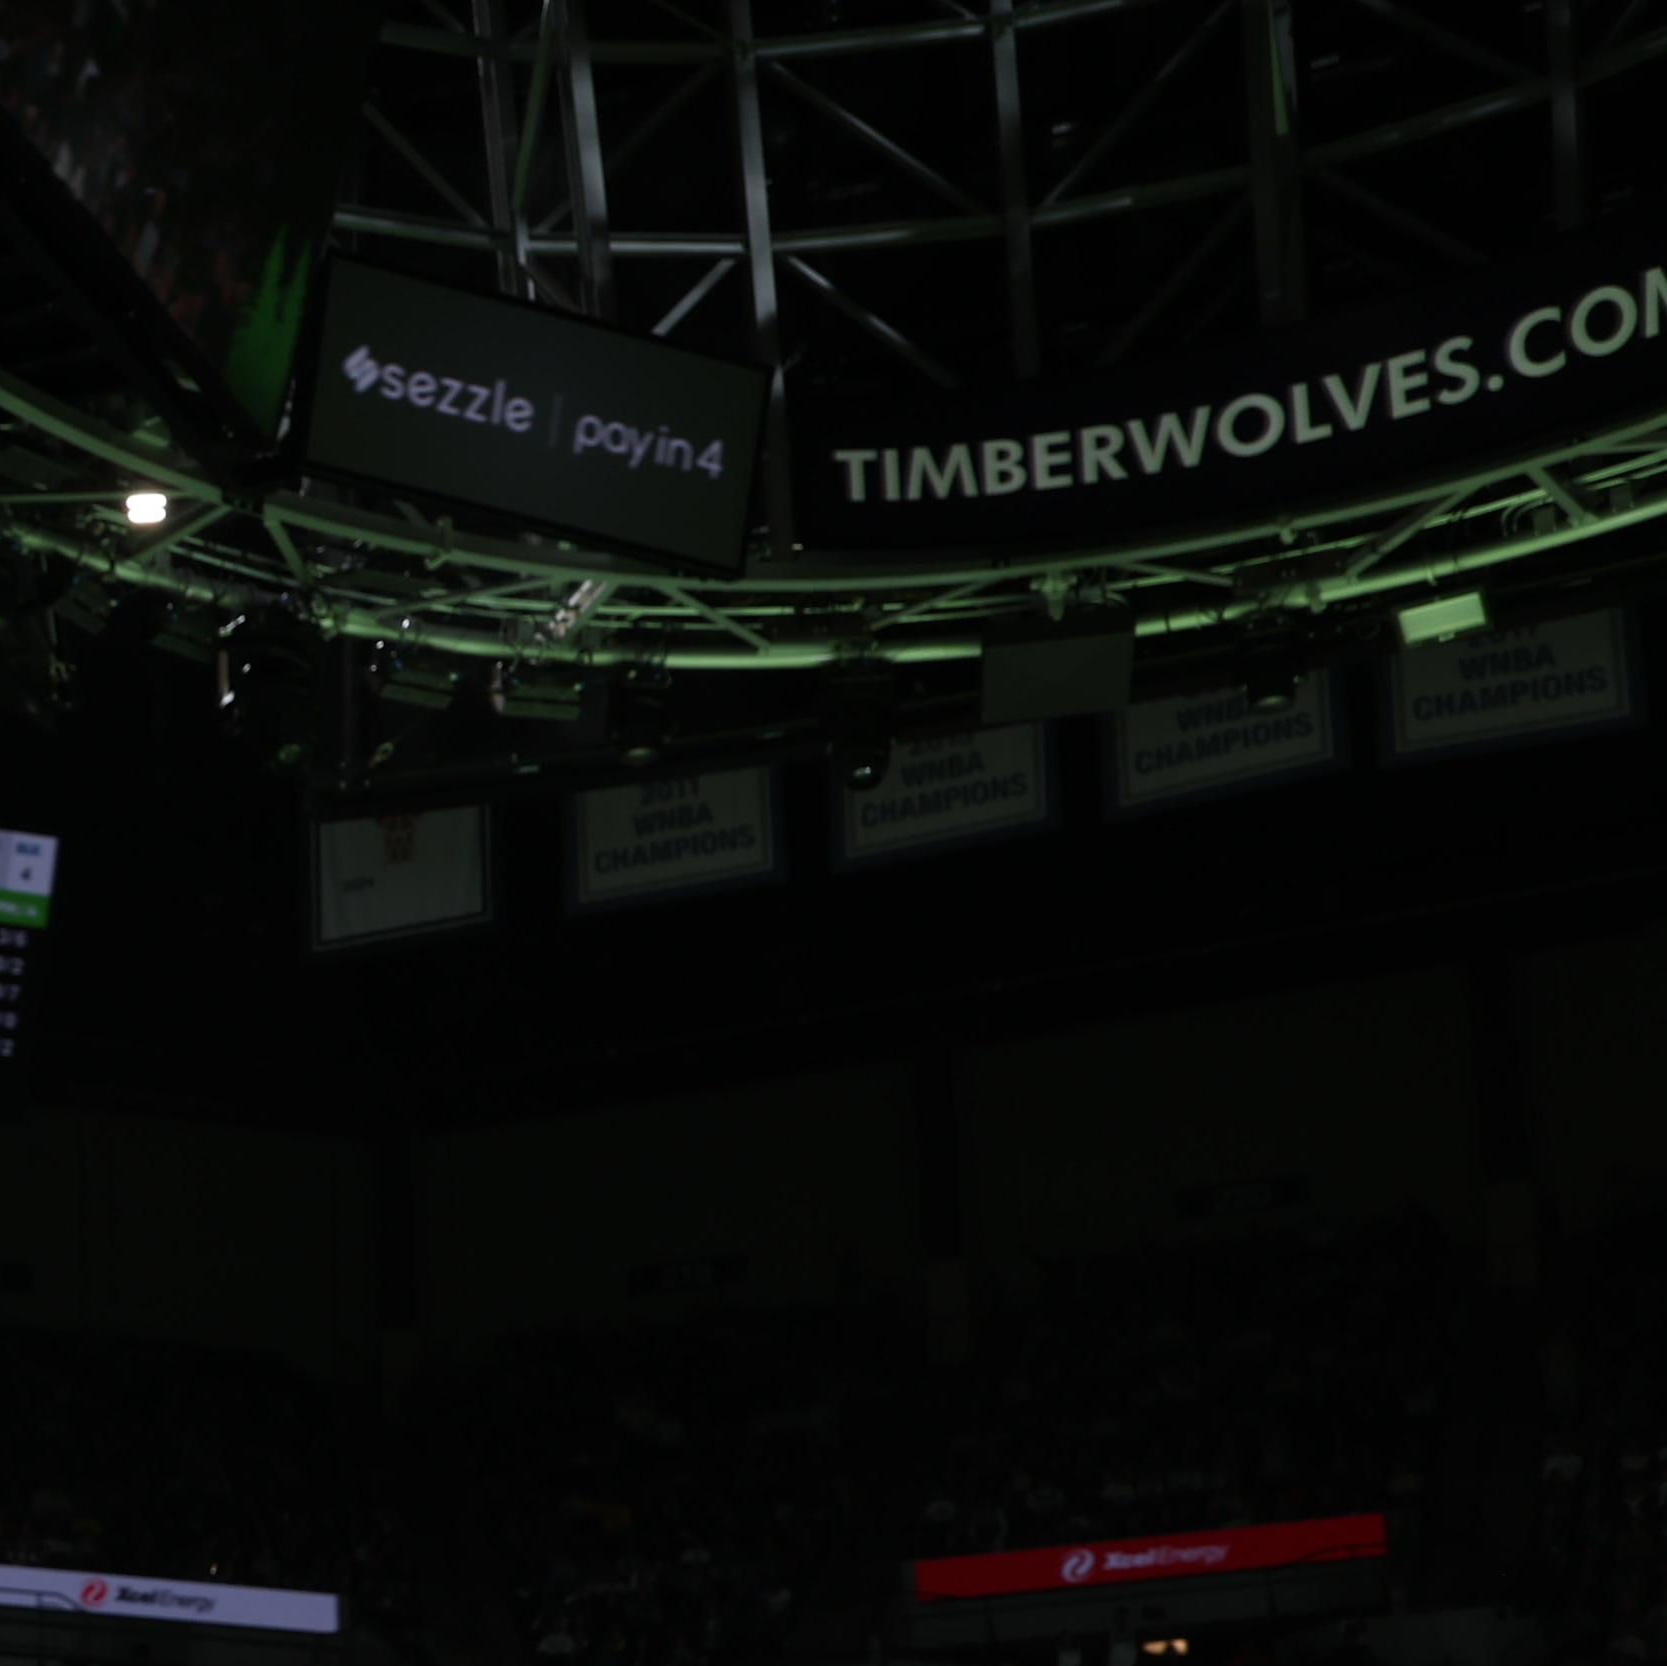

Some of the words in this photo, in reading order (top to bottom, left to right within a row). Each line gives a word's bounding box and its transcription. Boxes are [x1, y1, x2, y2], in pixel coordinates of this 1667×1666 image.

[380, 363, 535, 432] sezzle
[1459, 643, 1555, 680] WNBA
[1176, 695, 1247, 732] WNB
[1412, 665, 1608, 721] CHAMPIONS
[1136, 711, 1313, 774] CHAMPIONS
[902, 752, 985, 788] WNBA
[633, 802, 713, 837] WNBA
[861, 771, 1028, 828] CHAMPIONS
[594, 823, 756, 874] CHAMPIONS
[115, 1583, 158, 1609] Xcel
[156, 1587, 216, 1614] Energy
